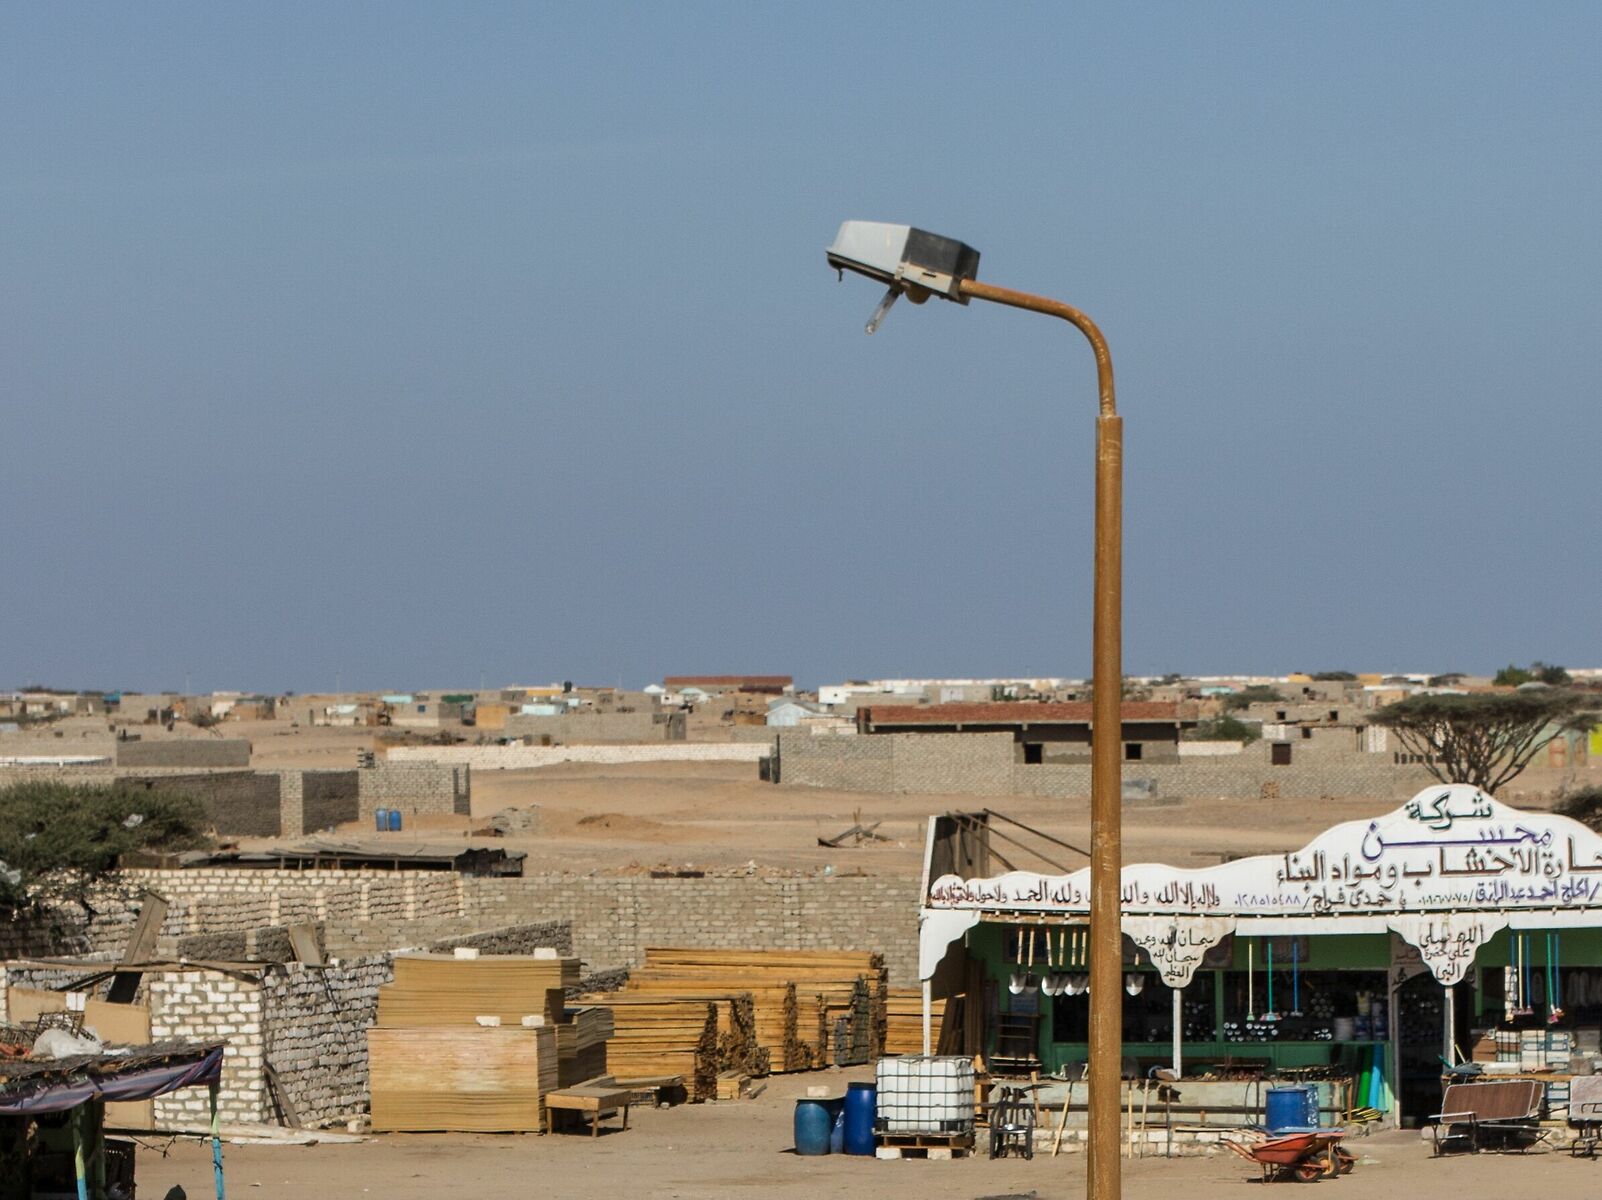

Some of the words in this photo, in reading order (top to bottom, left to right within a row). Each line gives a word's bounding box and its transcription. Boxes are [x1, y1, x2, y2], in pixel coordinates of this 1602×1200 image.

[1405, 792, 1492, 829] شركة
[1362, 822, 1552, 861] محسن
[1277, 850, 1325, 892] البناء
